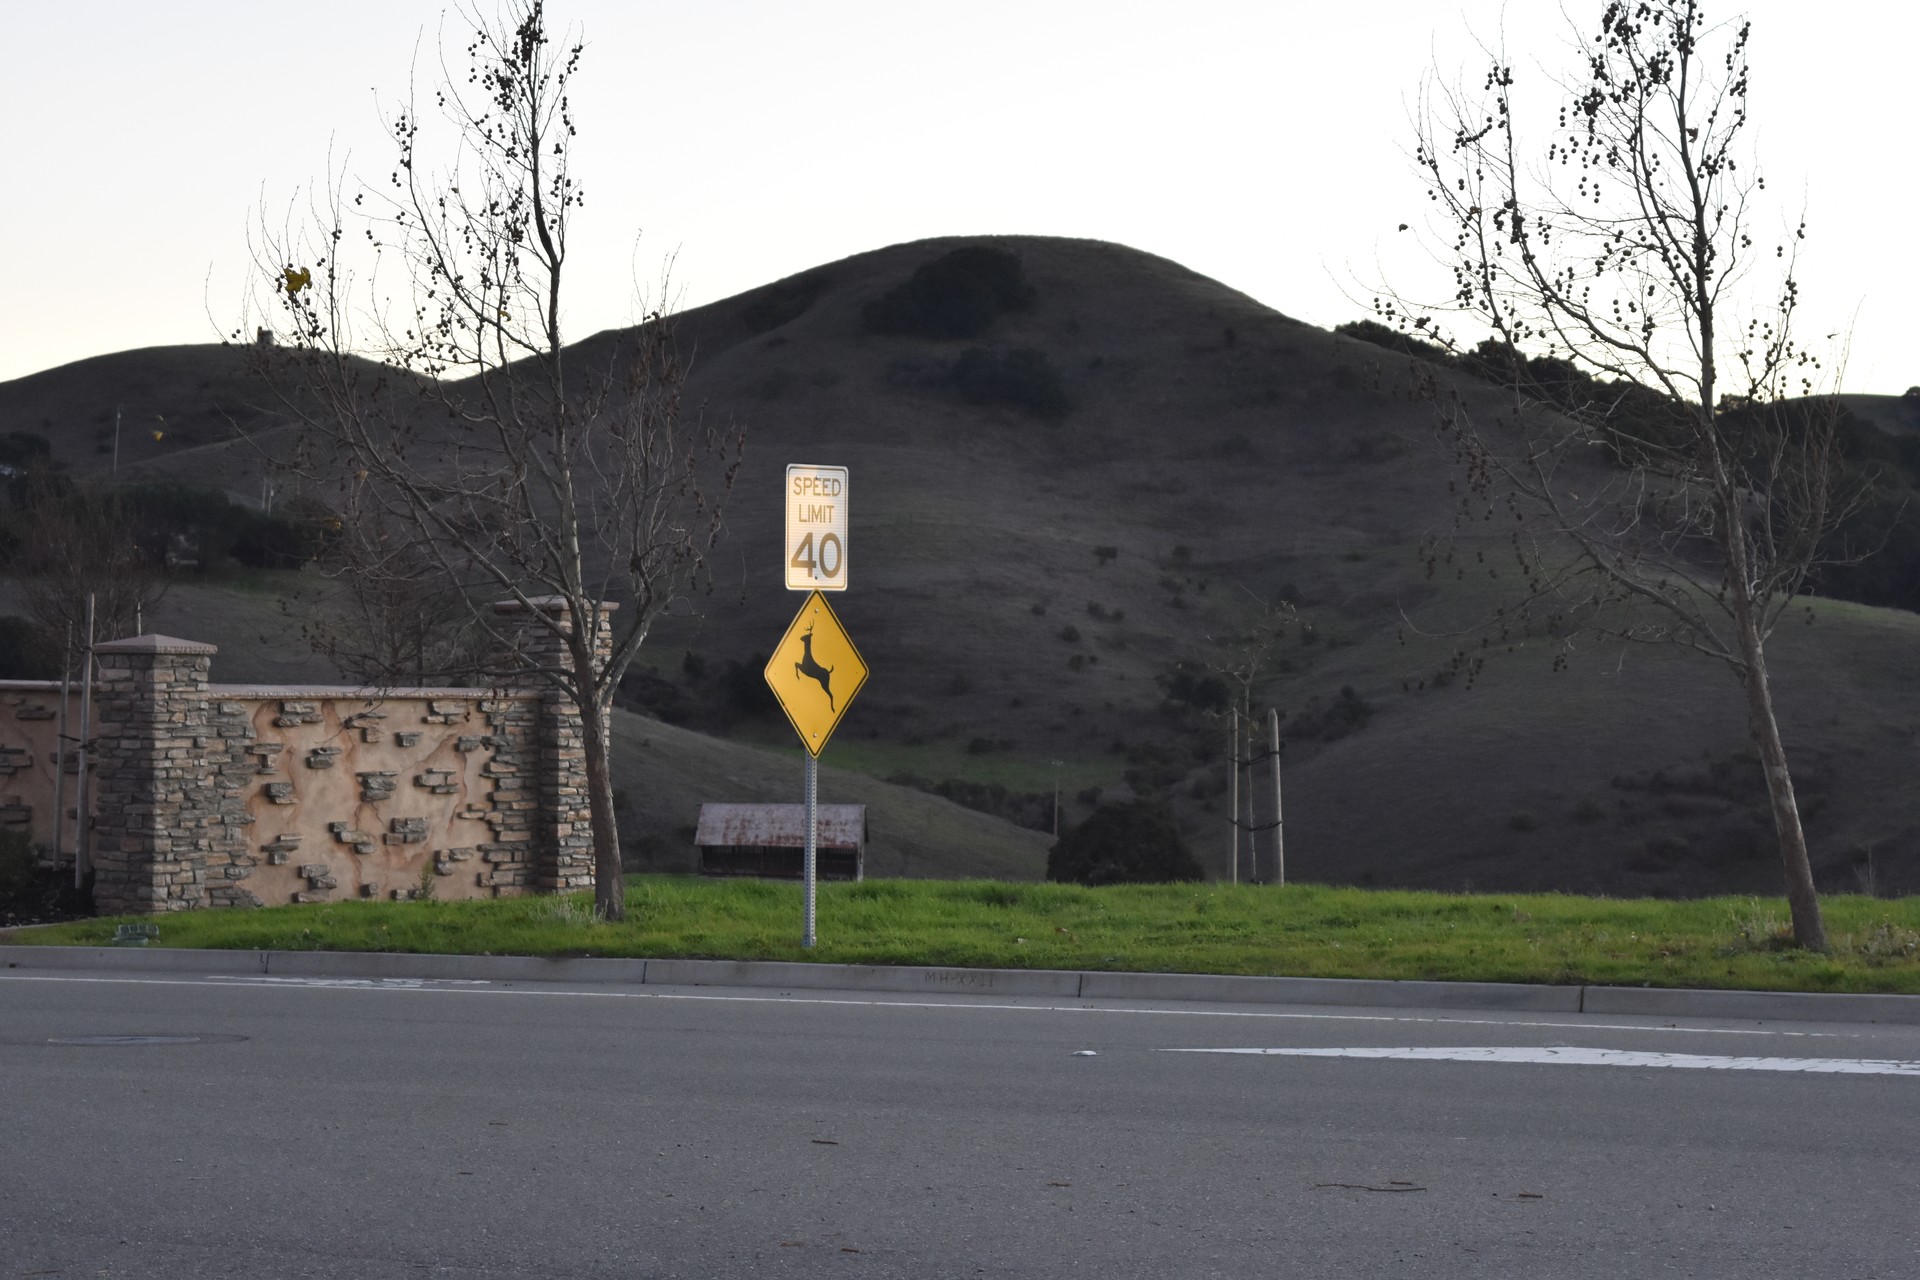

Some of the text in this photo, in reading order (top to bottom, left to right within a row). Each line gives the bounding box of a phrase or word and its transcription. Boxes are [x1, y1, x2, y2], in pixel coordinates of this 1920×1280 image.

[793, 476, 842, 497] SPEED
[798, 504, 835, 524] LIMIT
[791, 532, 842, 578] 40
